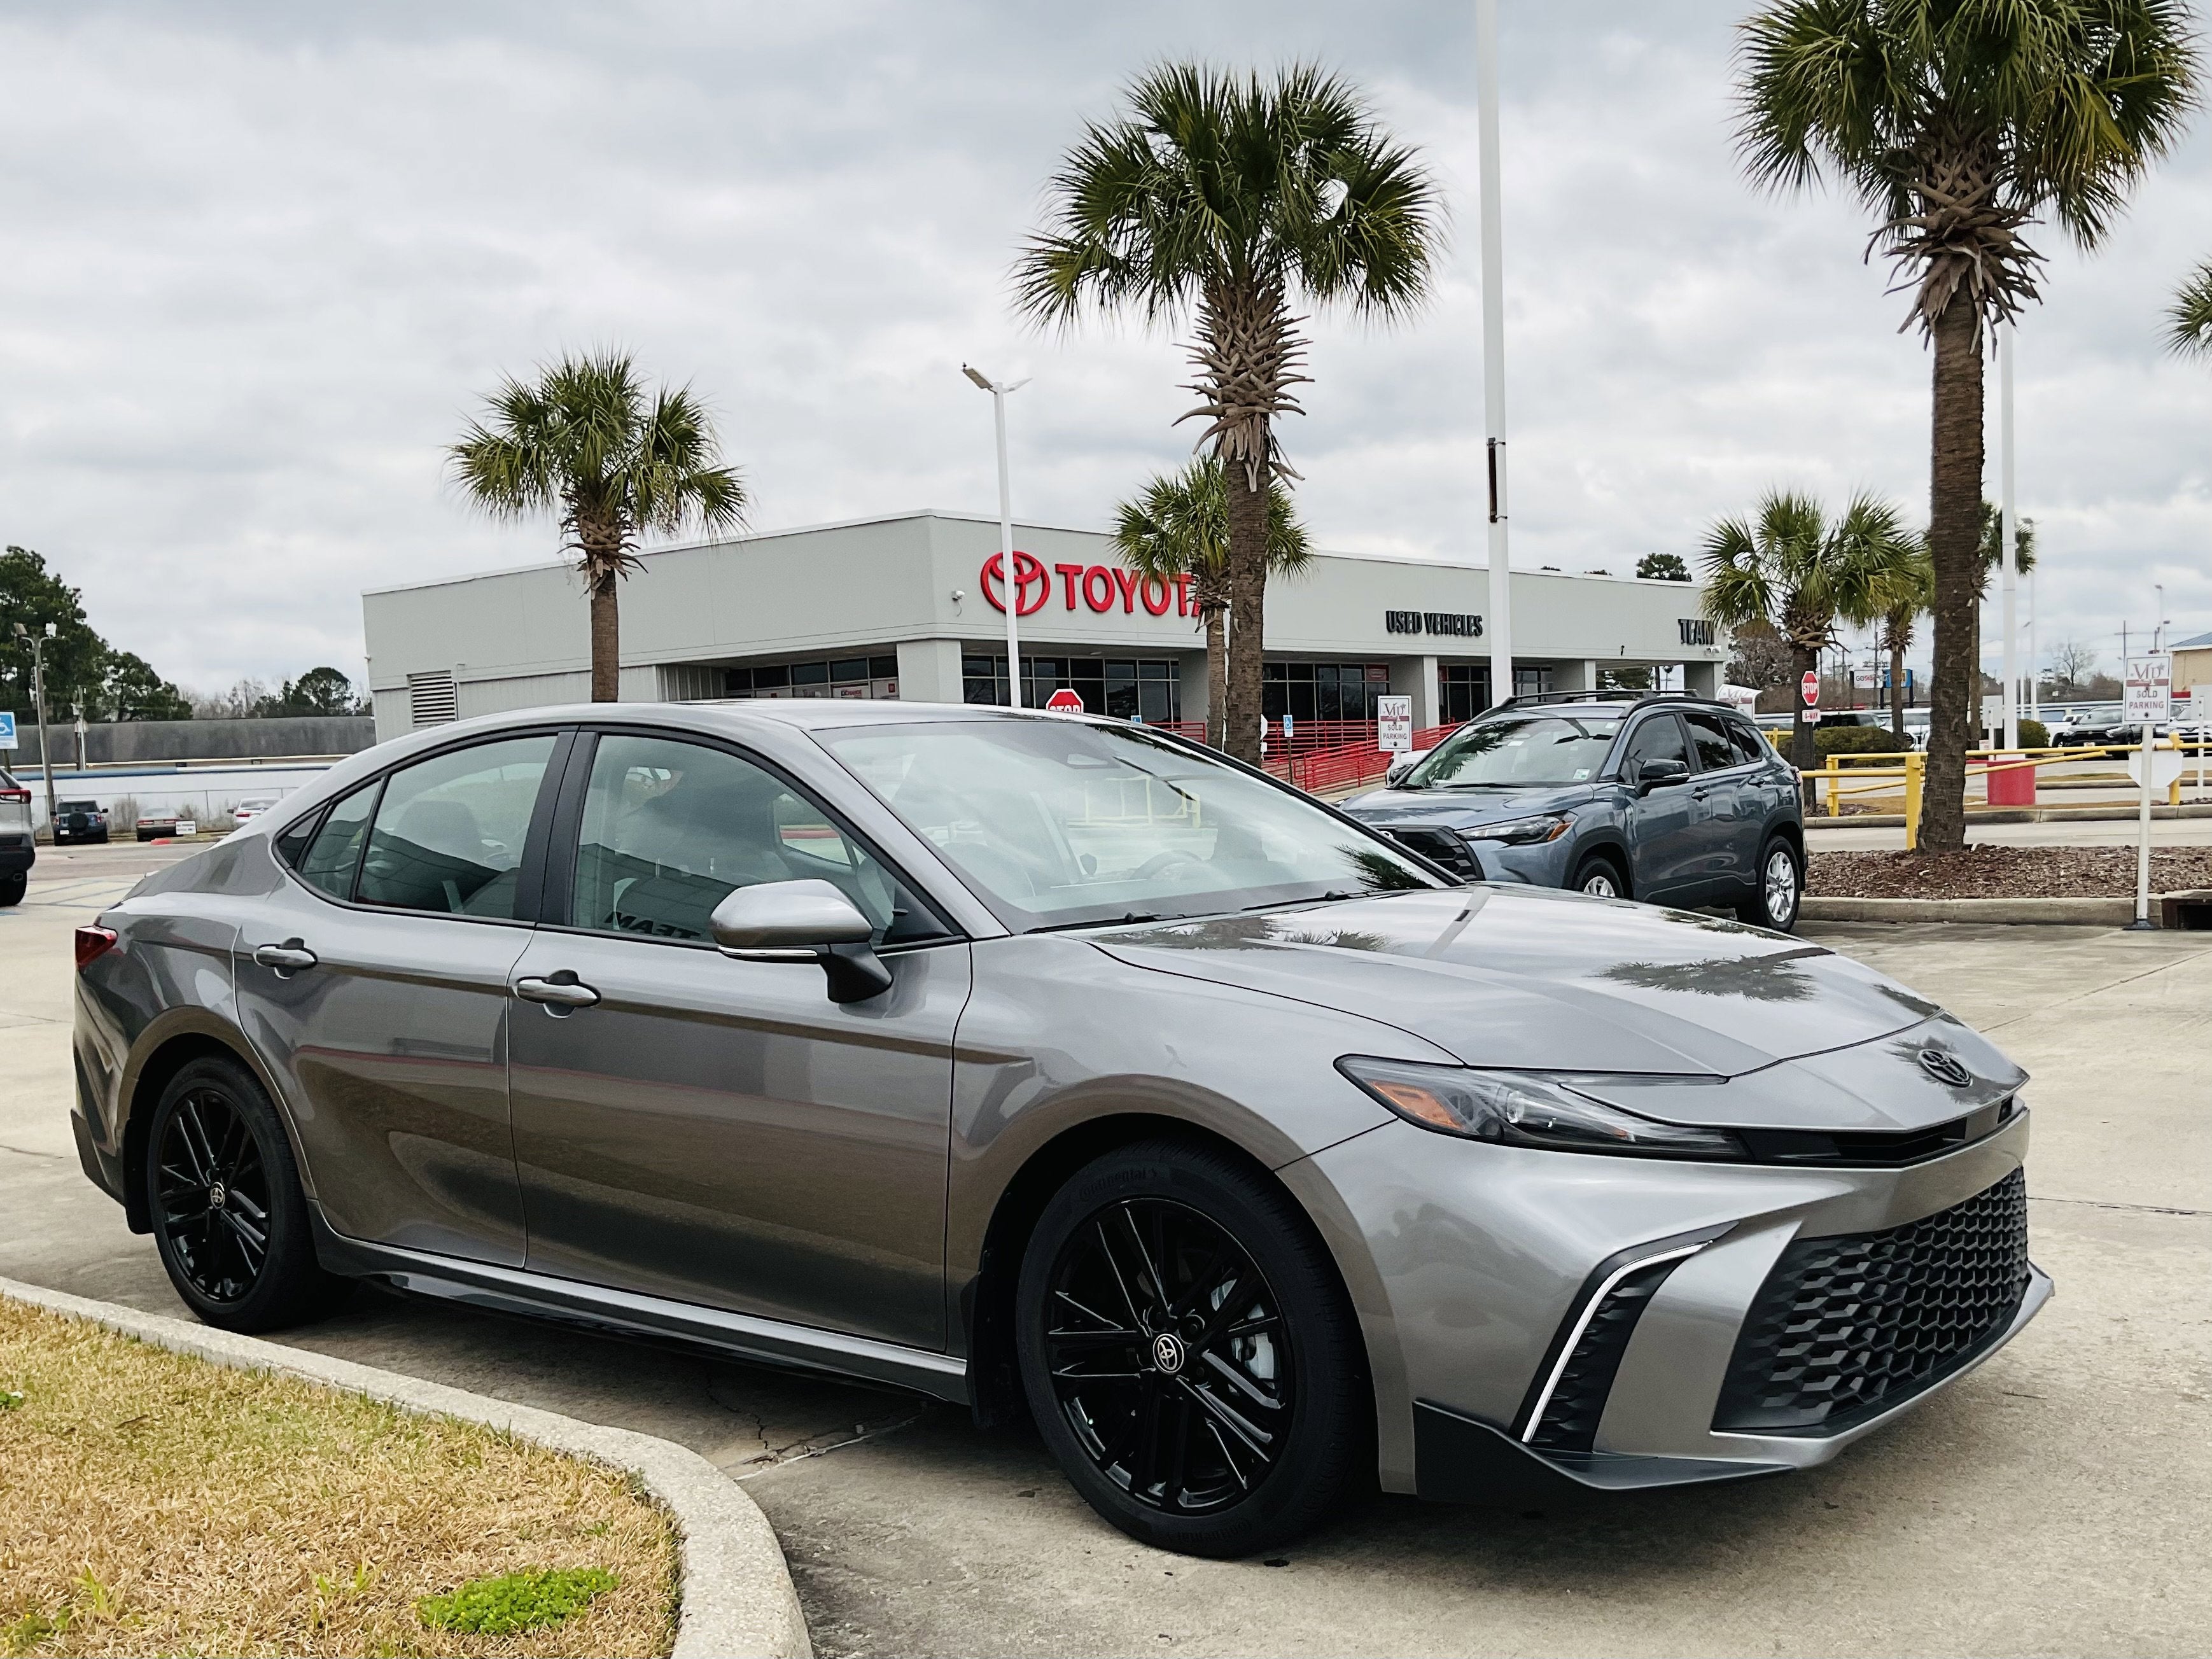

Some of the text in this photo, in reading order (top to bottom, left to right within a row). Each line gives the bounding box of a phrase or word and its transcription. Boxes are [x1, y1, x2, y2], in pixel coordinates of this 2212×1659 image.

[1055, 563, 1202, 617] TOYOT
[1386, 611, 1483, 636] USED VEHICLES
[1677, 619, 1715, 645] TEAM
[1803, 682, 1817, 694] STOP
